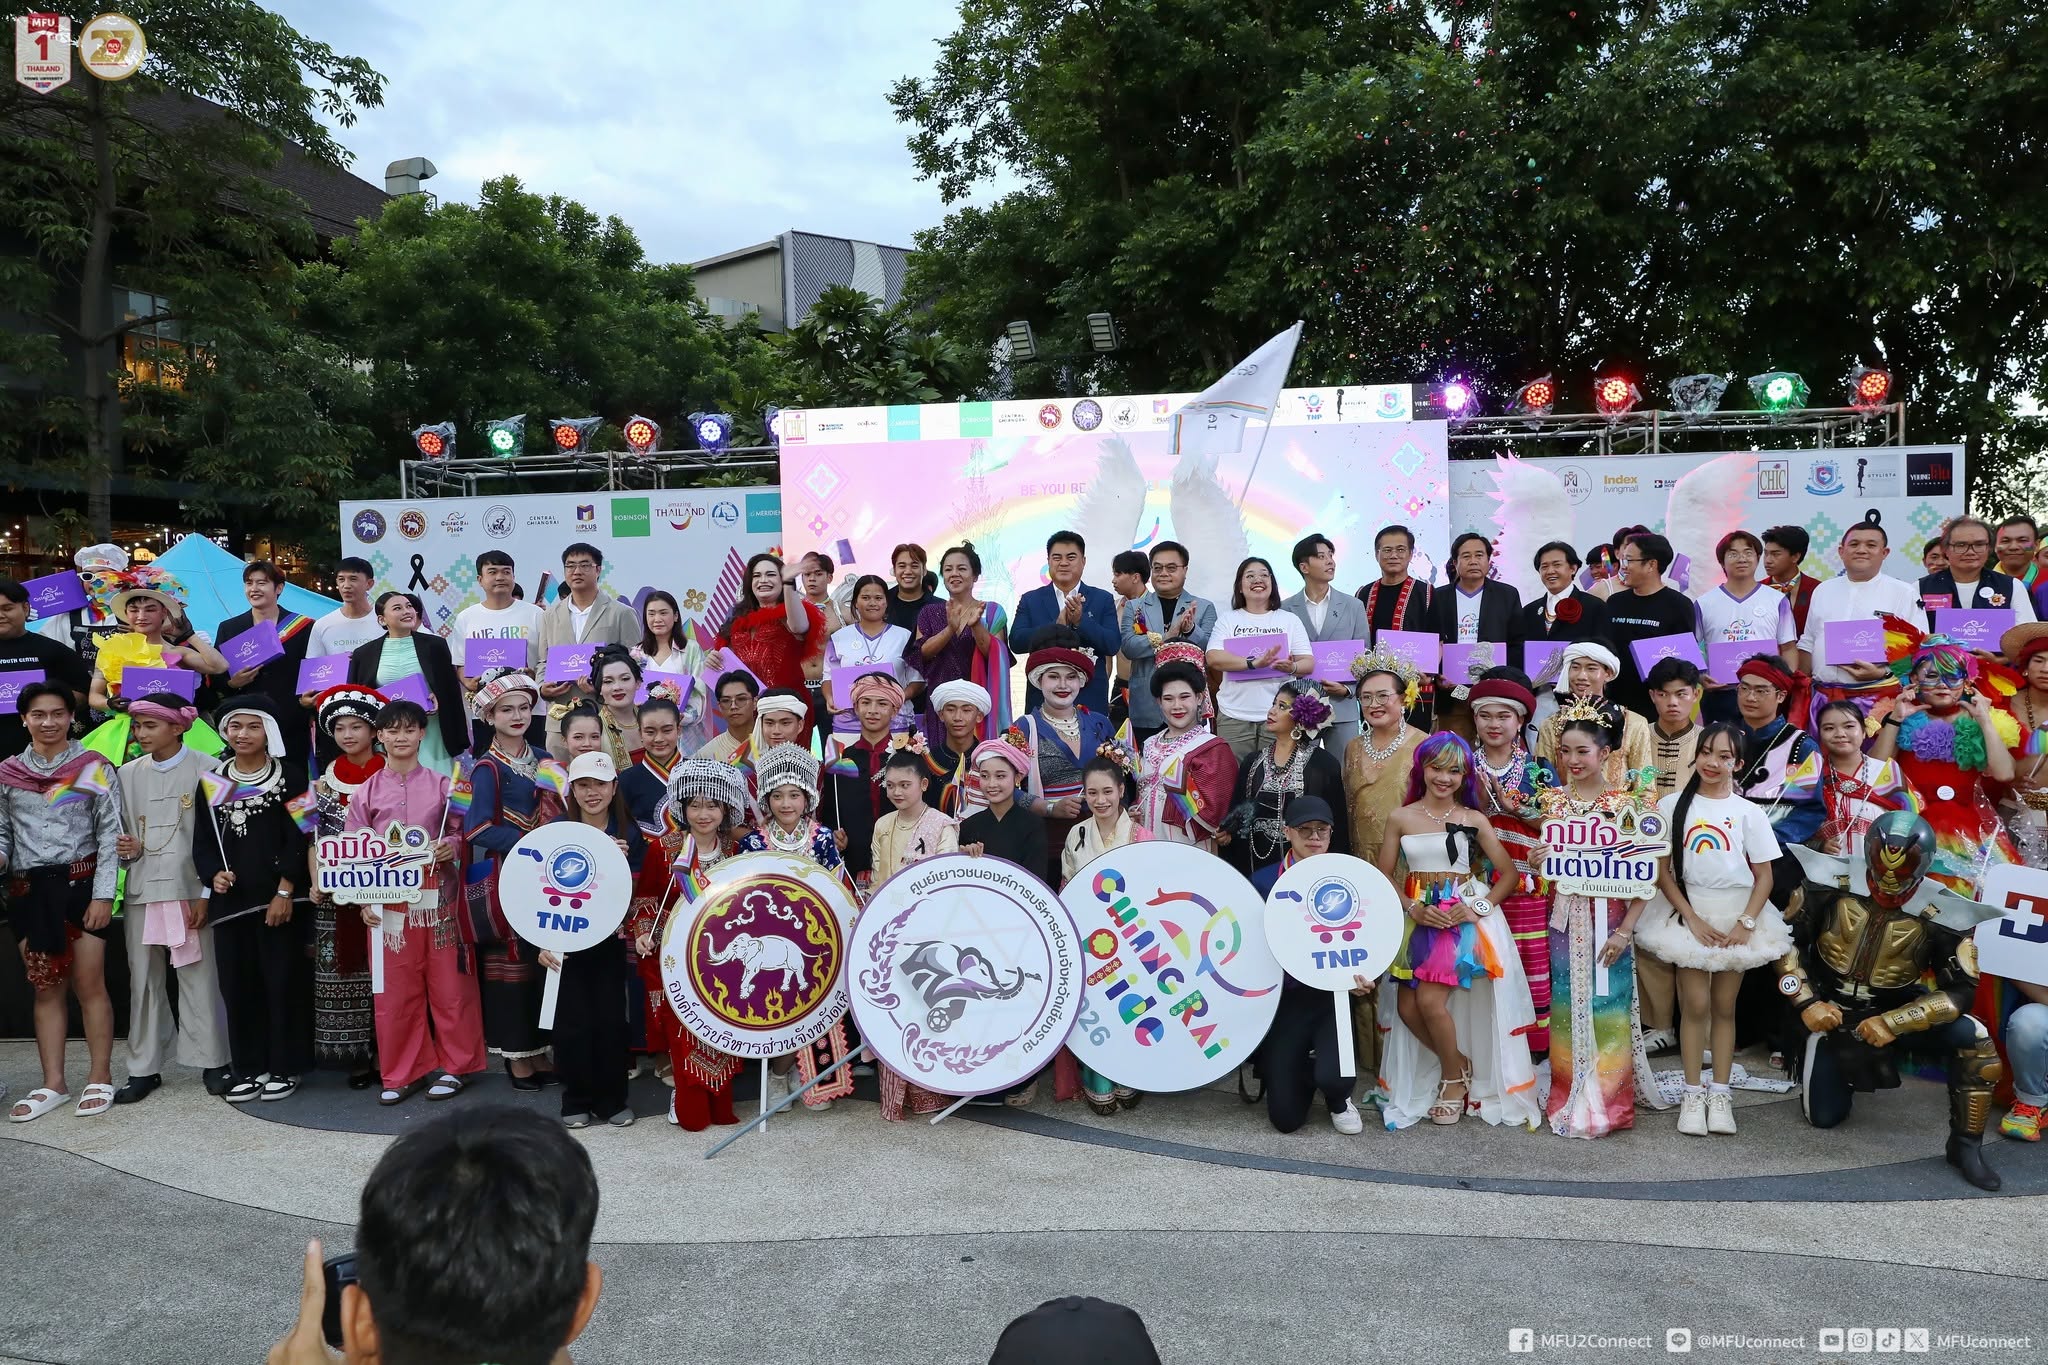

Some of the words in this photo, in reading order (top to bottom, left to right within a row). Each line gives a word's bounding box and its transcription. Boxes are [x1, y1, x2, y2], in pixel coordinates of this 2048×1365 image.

[1020, 484, 1036, 496] BE
[1041, 483, 1065, 495] YOU
[1604, 475, 1638, 485] Index
[1604, 485, 1639, 494] livingmall
[1760, 470, 1786, 490] CHIC
[655, 508, 705, 517] THAILAND
[472, 627, 494, 639] WE
[500, 625, 528, 639] ARE
[1545, 816, 1617, 852] ภูมิใจ
[320, 832, 386, 866] ภูมิใจ
[323, 863, 419, 888] แต่งไทย
[1546, 851, 1654, 881] แต่งไทย
[536, 911, 590, 933] TNP
[1311, 948, 1368, 970] TNP
[1784, 980, 1796, 990] 04
